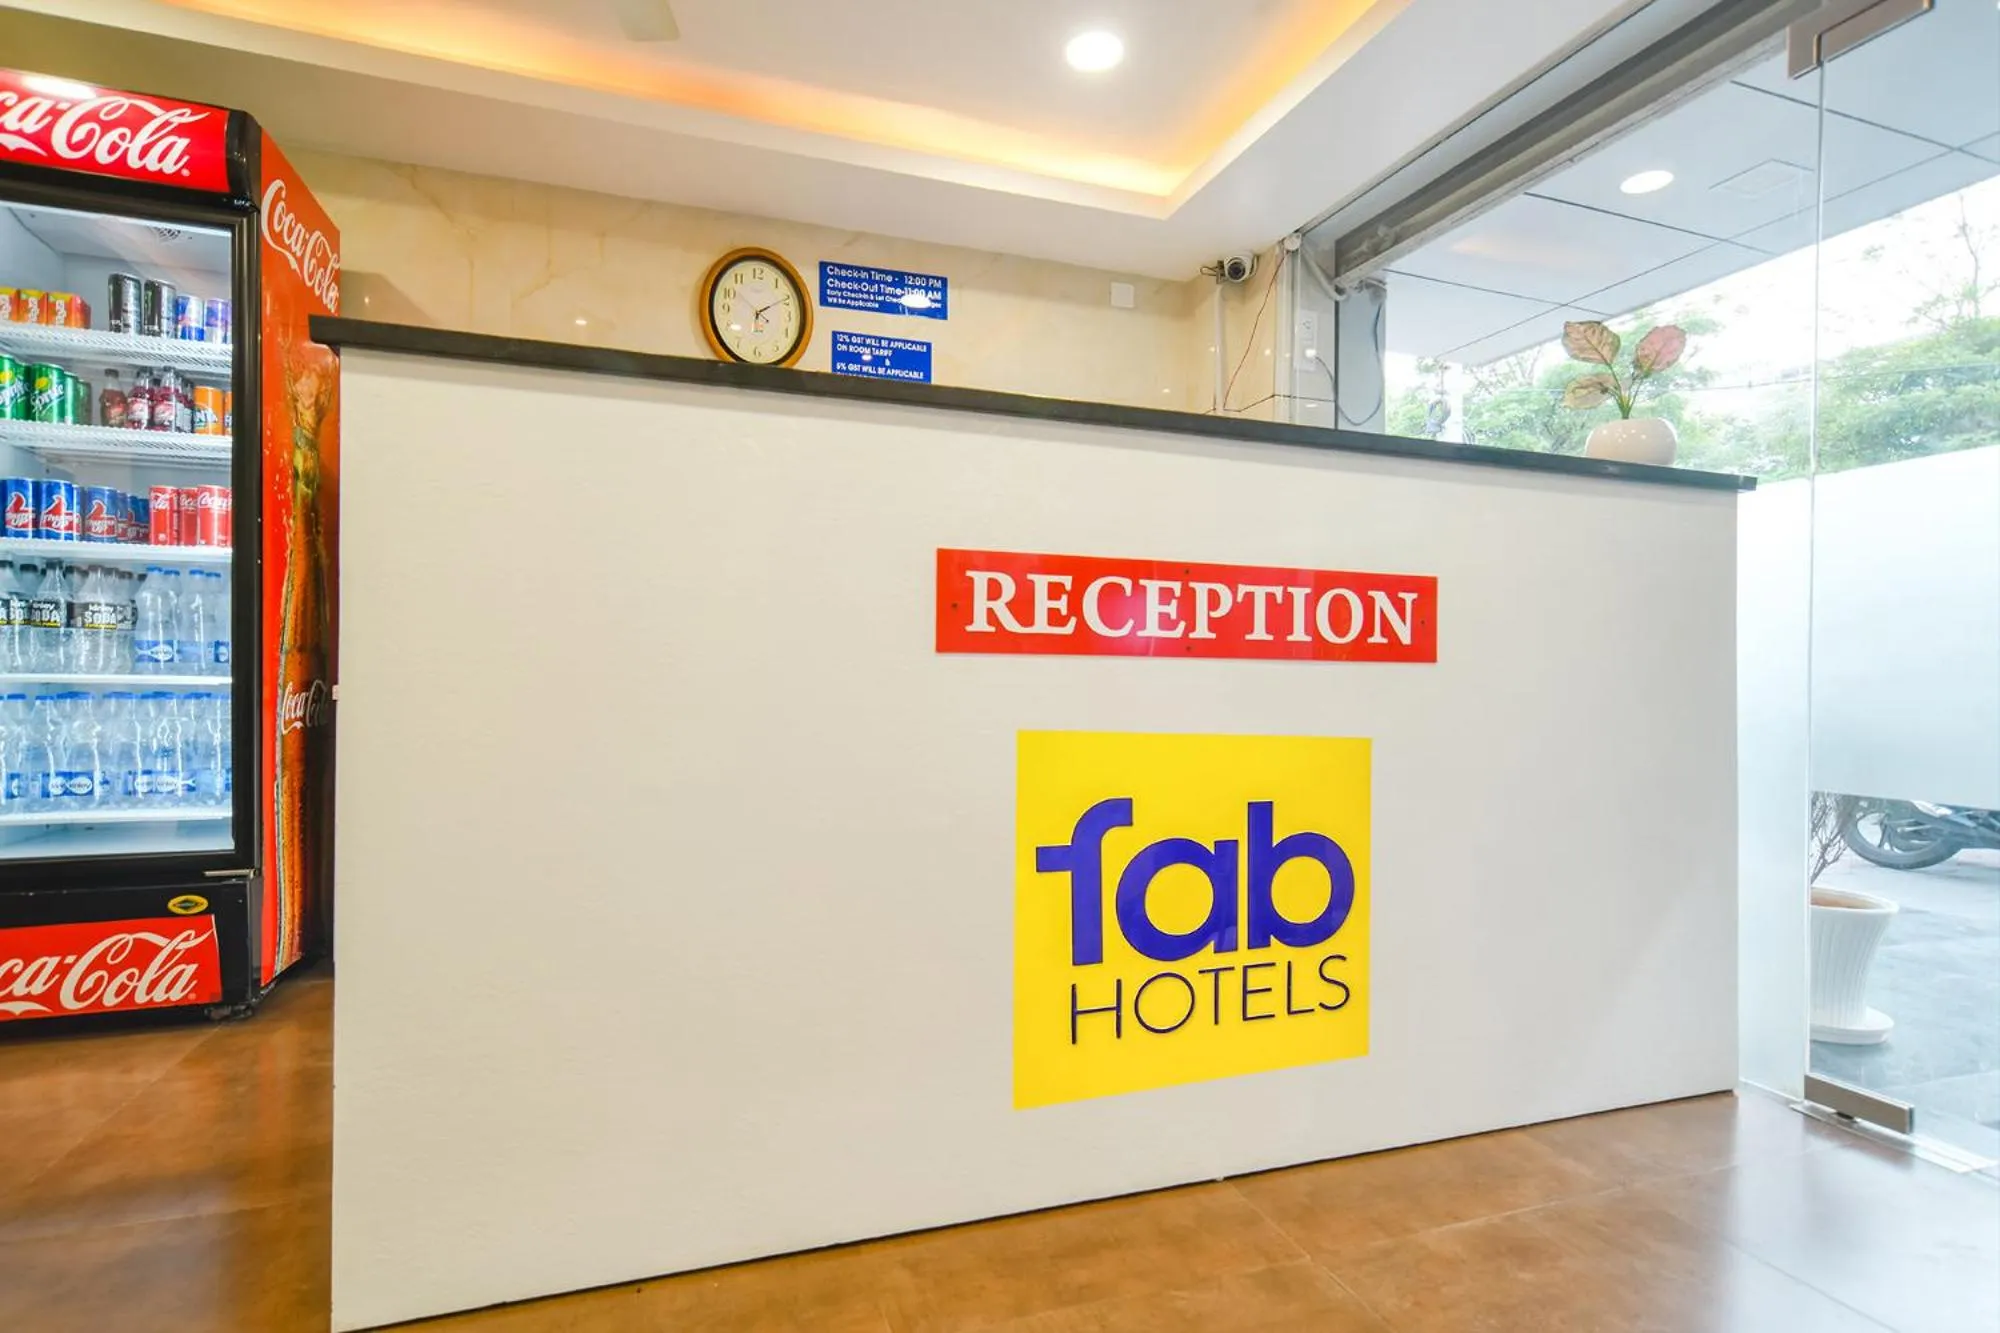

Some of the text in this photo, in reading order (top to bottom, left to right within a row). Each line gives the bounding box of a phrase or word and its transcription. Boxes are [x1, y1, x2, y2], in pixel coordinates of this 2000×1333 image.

[0, 91, 210, 174] ca-Cola
[261, 179, 340, 314] Coca-Cola
[734, 272, 744, 285] 11
[752, 267, 765, 281] 12
[871, 271, 893, 282] Time
[904, 275, 926, 286] 12:00
[928, 278, 941, 289] PM
[774, 277, 779, 289] 1
[826, 278, 878, 292] Check-Out
[927, 290, 941, 300] AM
[723, 287, 737, 300] 10
[783, 295, 790, 306] 2
[722, 302, 731, 313] 9
[836, 334, 850, 342] 12%
[851, 335, 864, 344] GST
[864, 338, 879, 346] WILL
[889, 341, 927, 352] APPLICABLE
[849, 344, 871, 354] ROOM
[753, 346, 762, 358] 6
[847, 363, 861, 372] GST
[861, 365, 876, 374] WILL
[886, 367, 924, 379] APPLICABLE
[964, 569, 1418, 646] RECEPTION
[84, 610, 117, 624] SODA
[1036, 797, 1355, 966] fab
[0, 929, 214, 1015] ca-Cola
[1071, 954, 1350, 1045] HOTELS
